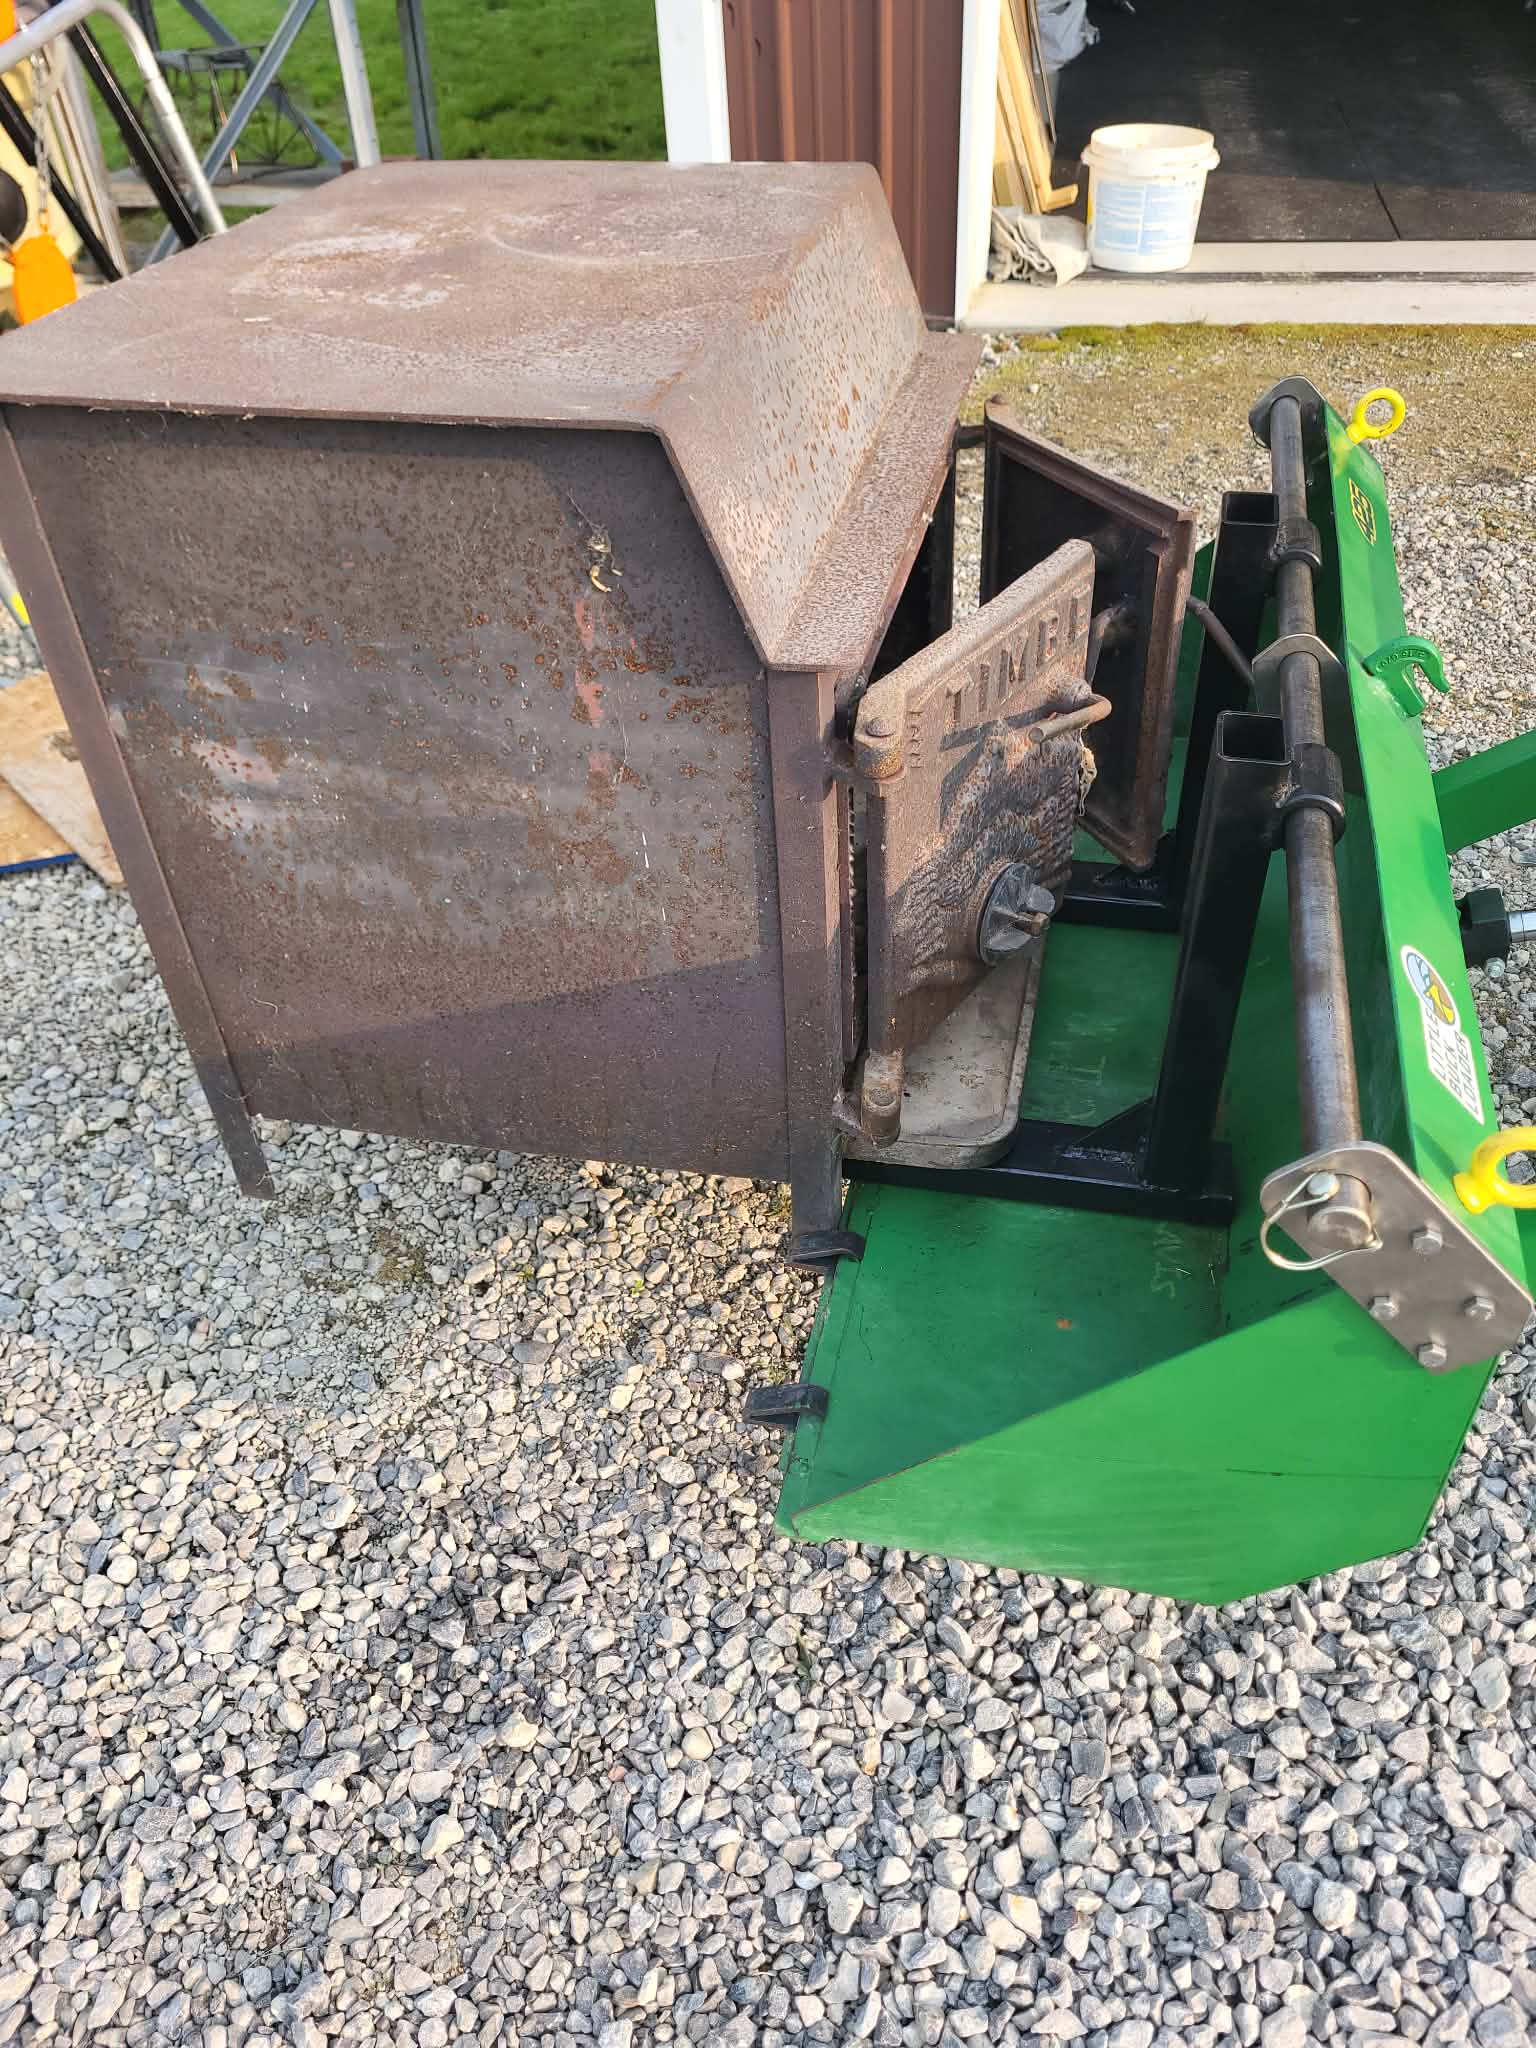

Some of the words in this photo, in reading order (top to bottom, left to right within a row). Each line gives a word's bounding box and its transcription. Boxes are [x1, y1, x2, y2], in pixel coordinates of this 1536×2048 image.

[1424, 1006, 1448, 1082] LITTLE
[1445, 1043, 1462, 1098] BUCK
[1454, 1030, 1479, 1116] LOADER
